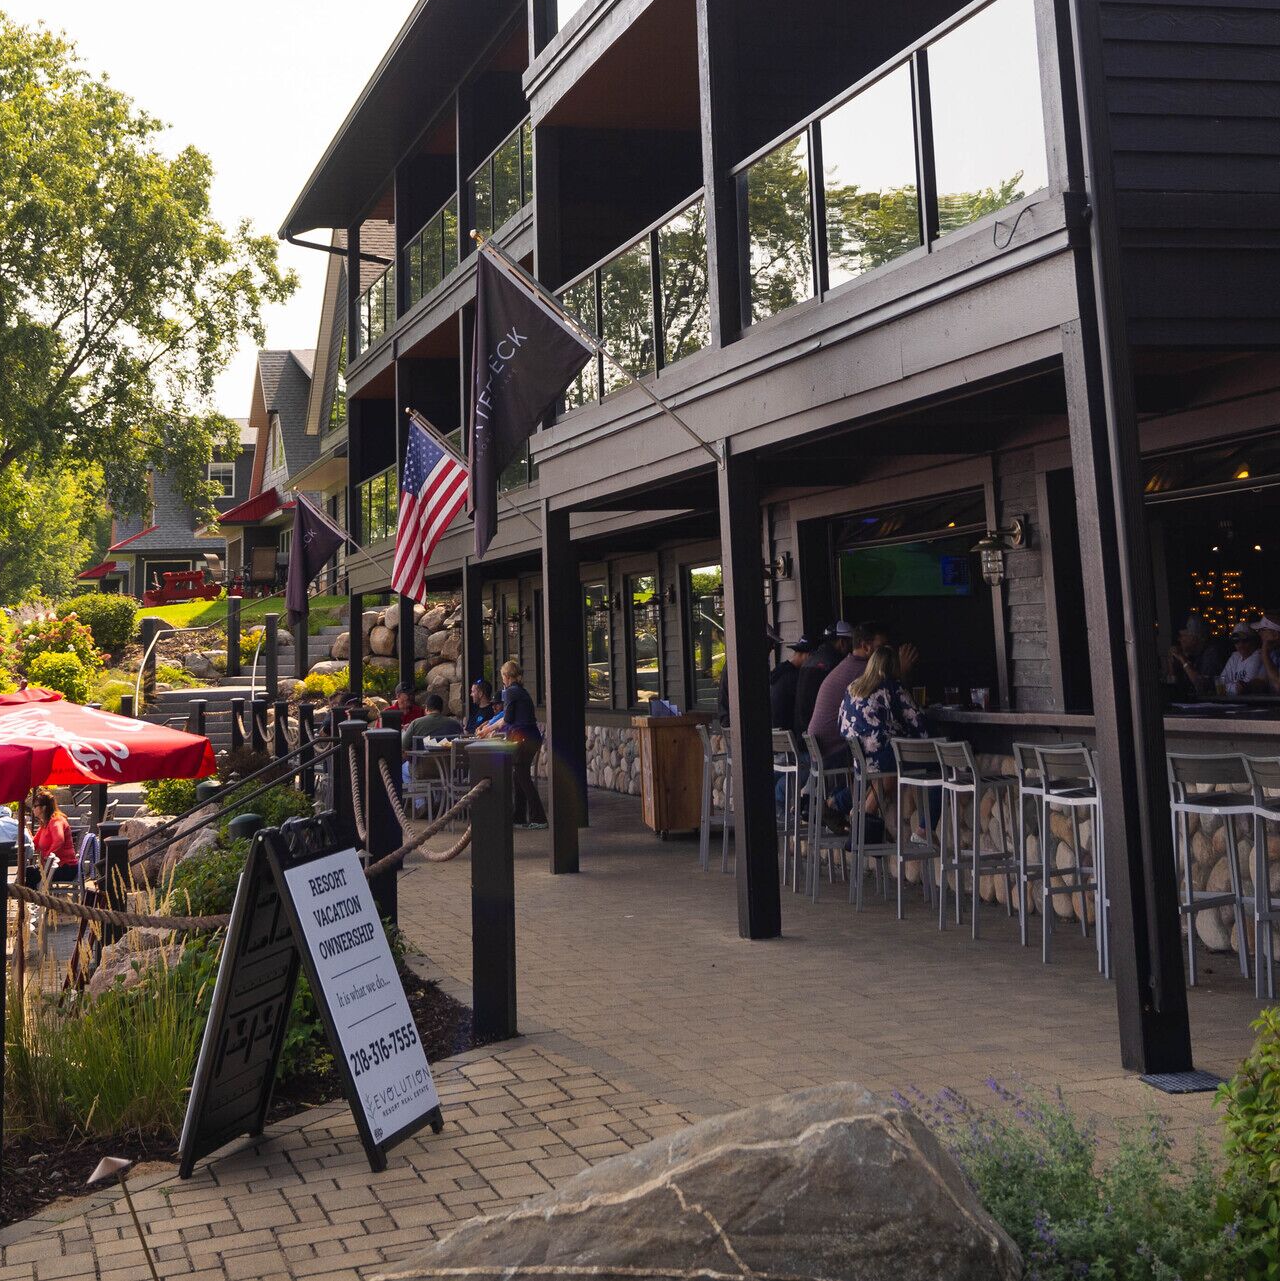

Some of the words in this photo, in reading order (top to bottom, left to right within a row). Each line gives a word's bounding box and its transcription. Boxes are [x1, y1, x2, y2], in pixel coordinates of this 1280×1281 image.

[308, 868, 347, 897] RESORT
[312, 895, 363, 928] VACATION
[318, 922, 375, 960] OWNERSHIP
[336, 992, 345, 1008] It
[342, 992, 351, 1005] is
[349, 984, 367, 1003] what
[365, 984, 377, 995] we
[350, 1022, 417, 1077] 218-316-7555
[373, 1066, 430, 1110] EVOLUTION
